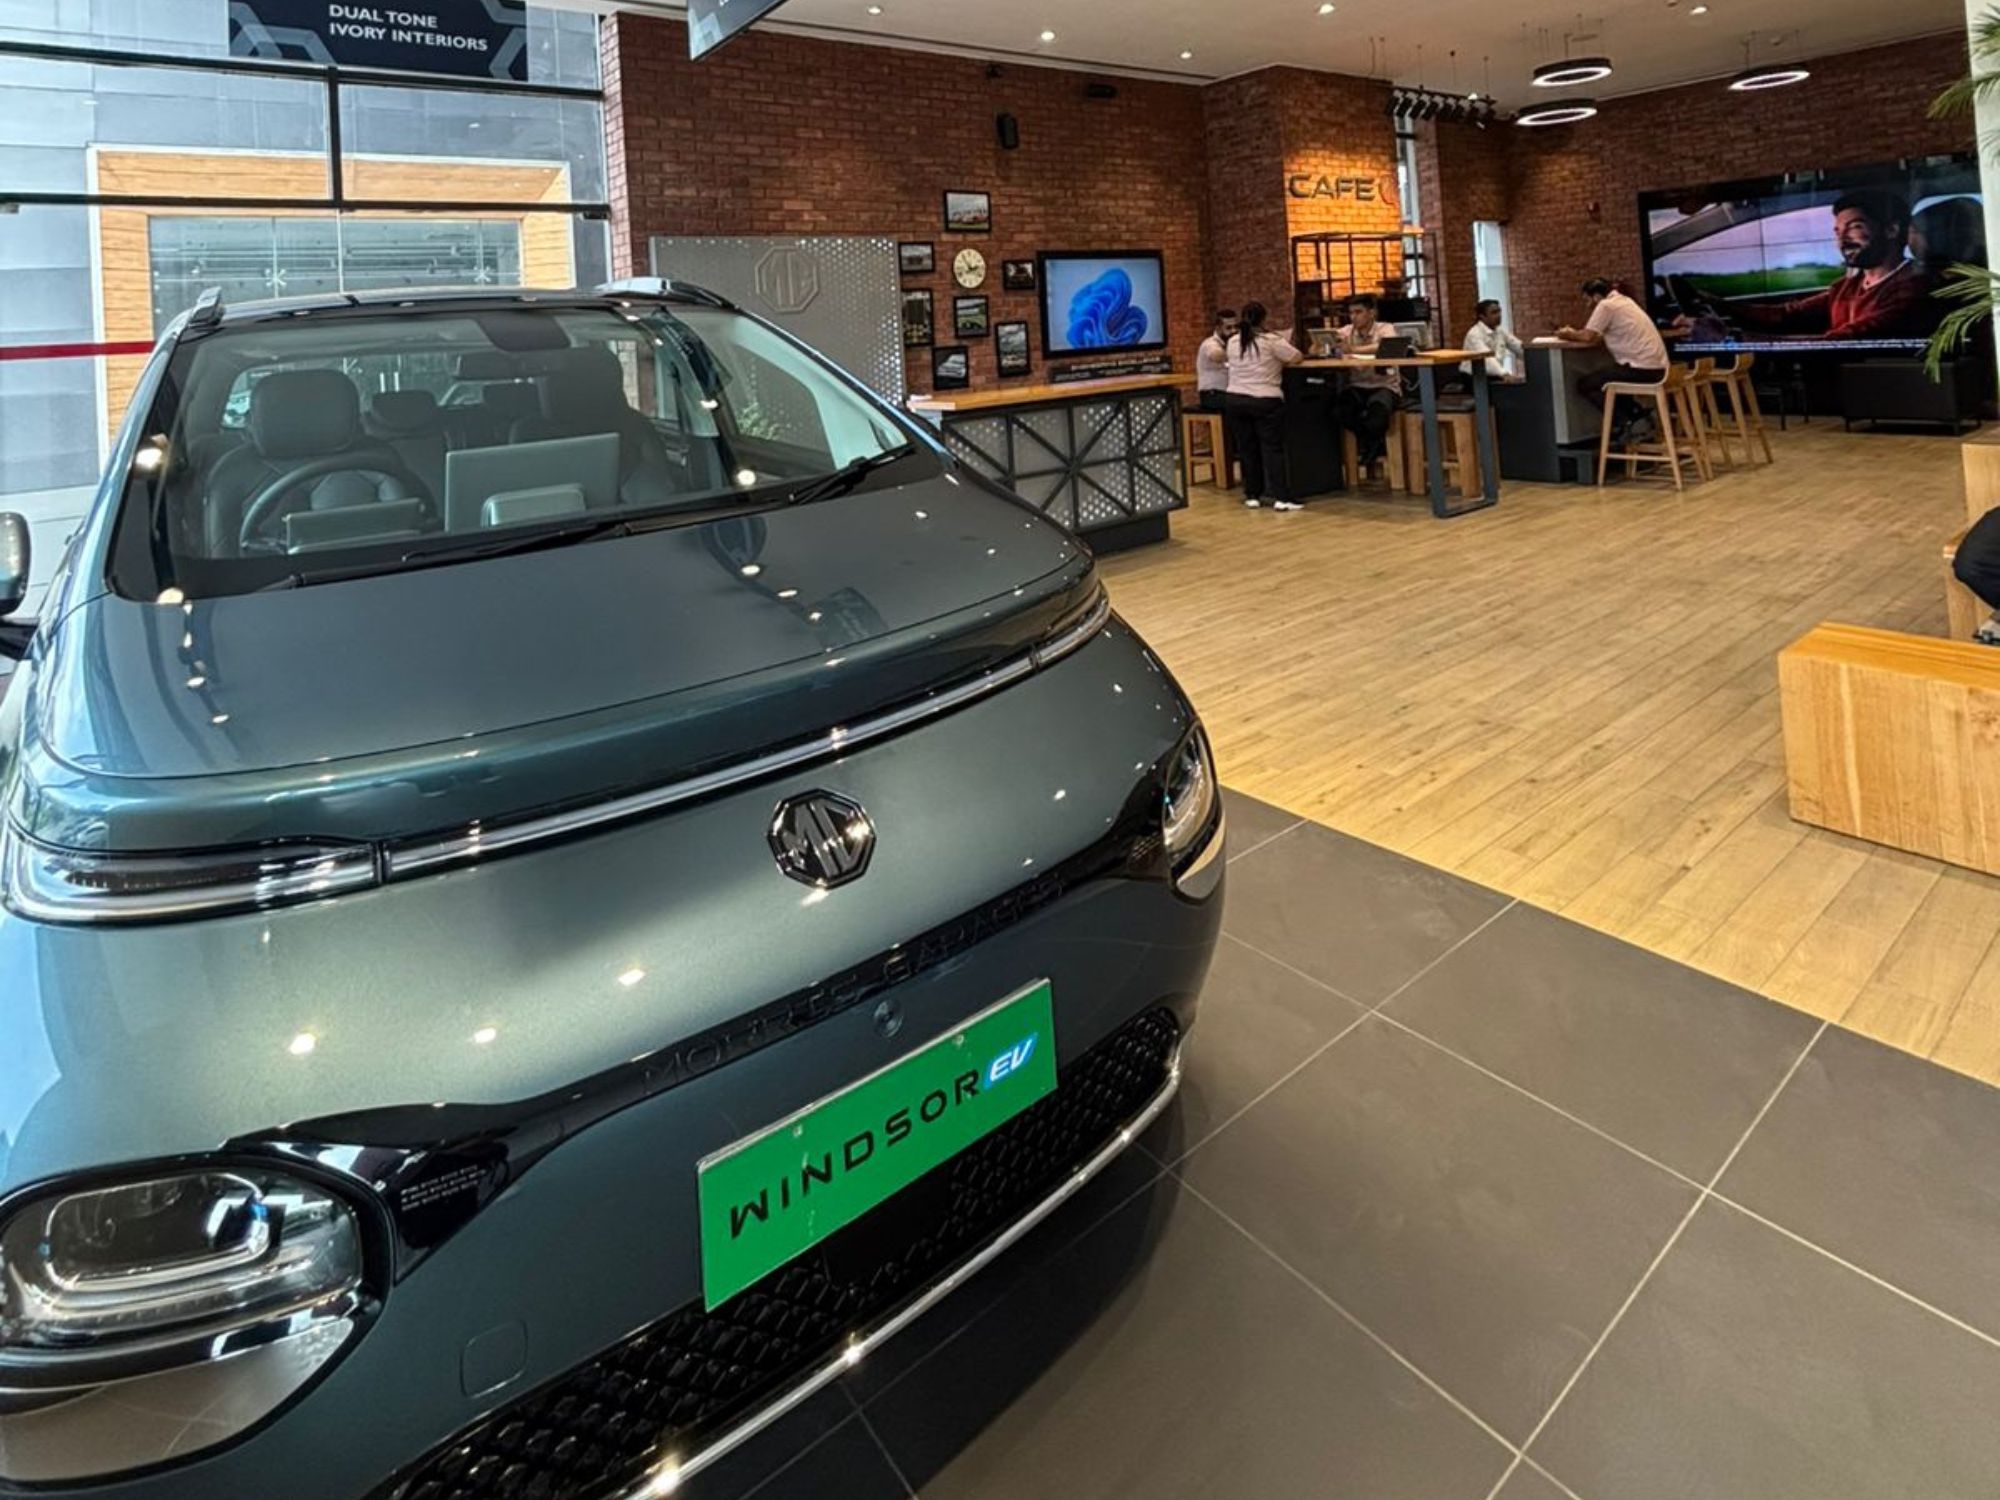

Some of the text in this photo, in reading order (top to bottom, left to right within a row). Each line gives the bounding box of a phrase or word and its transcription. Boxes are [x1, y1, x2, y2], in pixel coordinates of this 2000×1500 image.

[328, 4, 439, 29] DUAL TONE
[329, 22, 488, 51] IVORY INTERIORS
[1288, 172, 1376, 201] CAFE
[774, 795, 872, 883] MG
[730, 1036, 1035, 1240] WINDSOR EV
